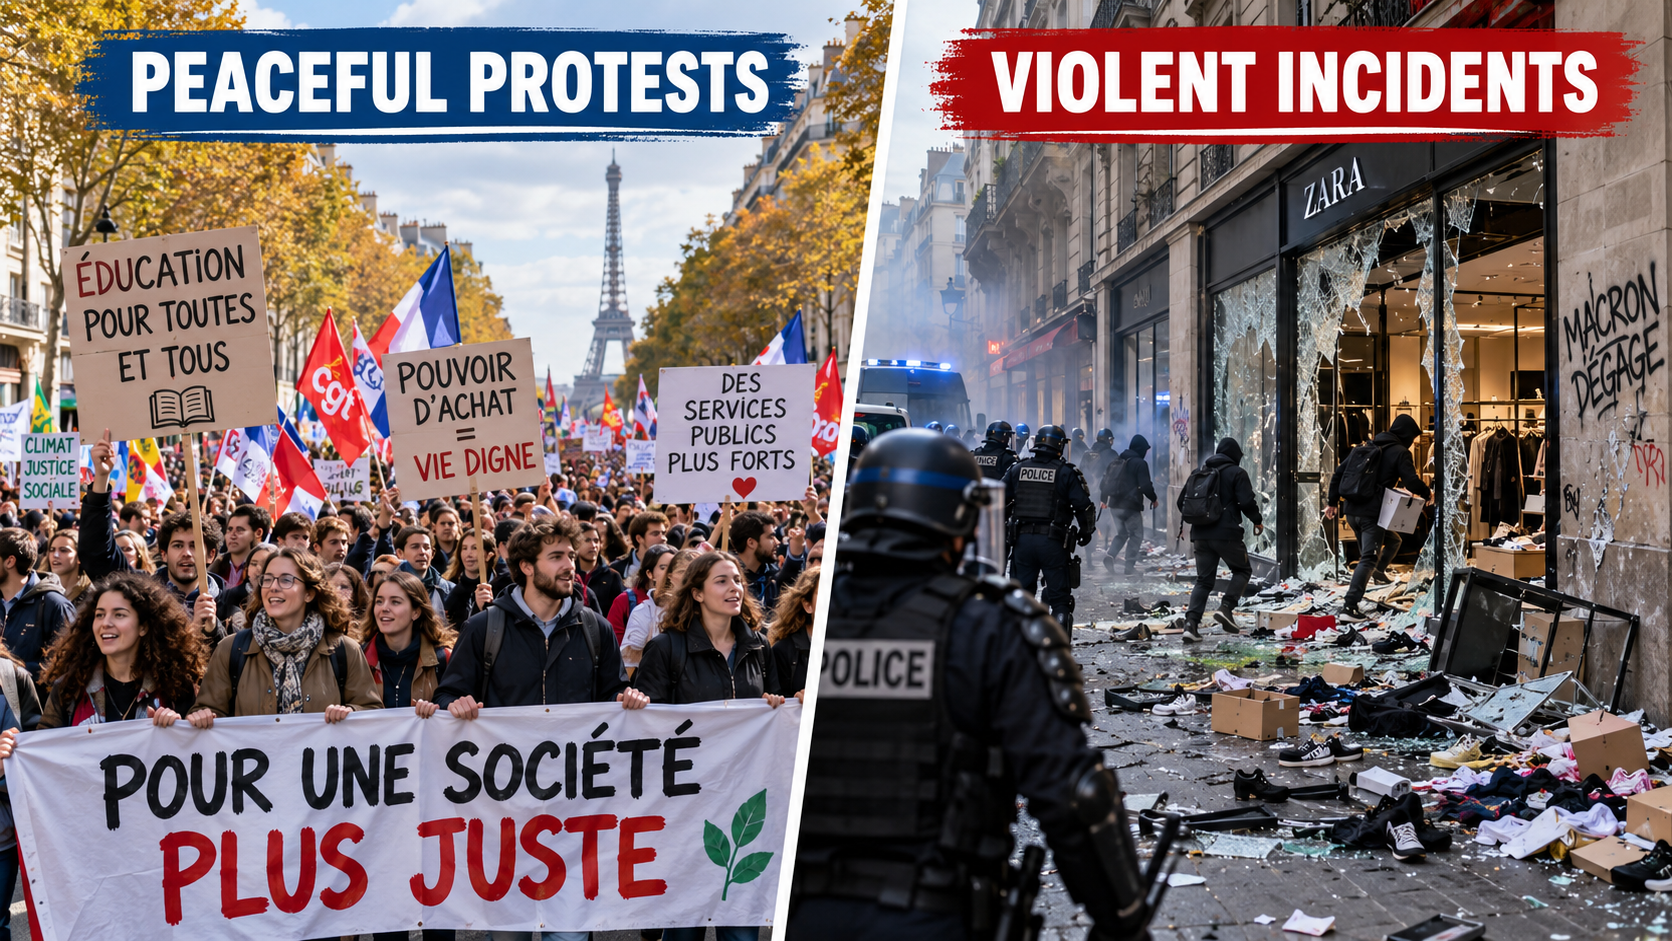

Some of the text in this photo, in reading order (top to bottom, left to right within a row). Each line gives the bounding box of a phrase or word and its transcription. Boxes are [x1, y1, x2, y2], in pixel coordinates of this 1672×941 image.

[1303, 157, 1366, 220] ZARA
[83, 292, 256, 342] POUR TOUTES
[1564, 262, 1660, 362] MACRON
[119, 340, 231, 383] ET TOUS
[397, 351, 517, 394] POUVOIR
[1571, 320, 1664, 418] DÉGAGE
[312, 366, 355, 421] cgt
[721, 372, 761, 394] DES
[684, 397, 787, 421] SERVICES
[25, 437, 75, 454] CLIMAT
[691, 423, 777, 447] PUBLICS
[24, 459, 76, 476] JUSTICE
[413, 441, 537, 482] VIE DIGNE
[668, 452, 719, 474] PLUS
[730, 450, 796, 472] FORTS
[1021, 469, 1054, 481] POLICE
[23, 482, 76, 499] SOCIALE
[100, 719, 702, 831] POUR UNE SOCIÉTÉ
[160, 813, 668, 925] PLUS JUSTE
